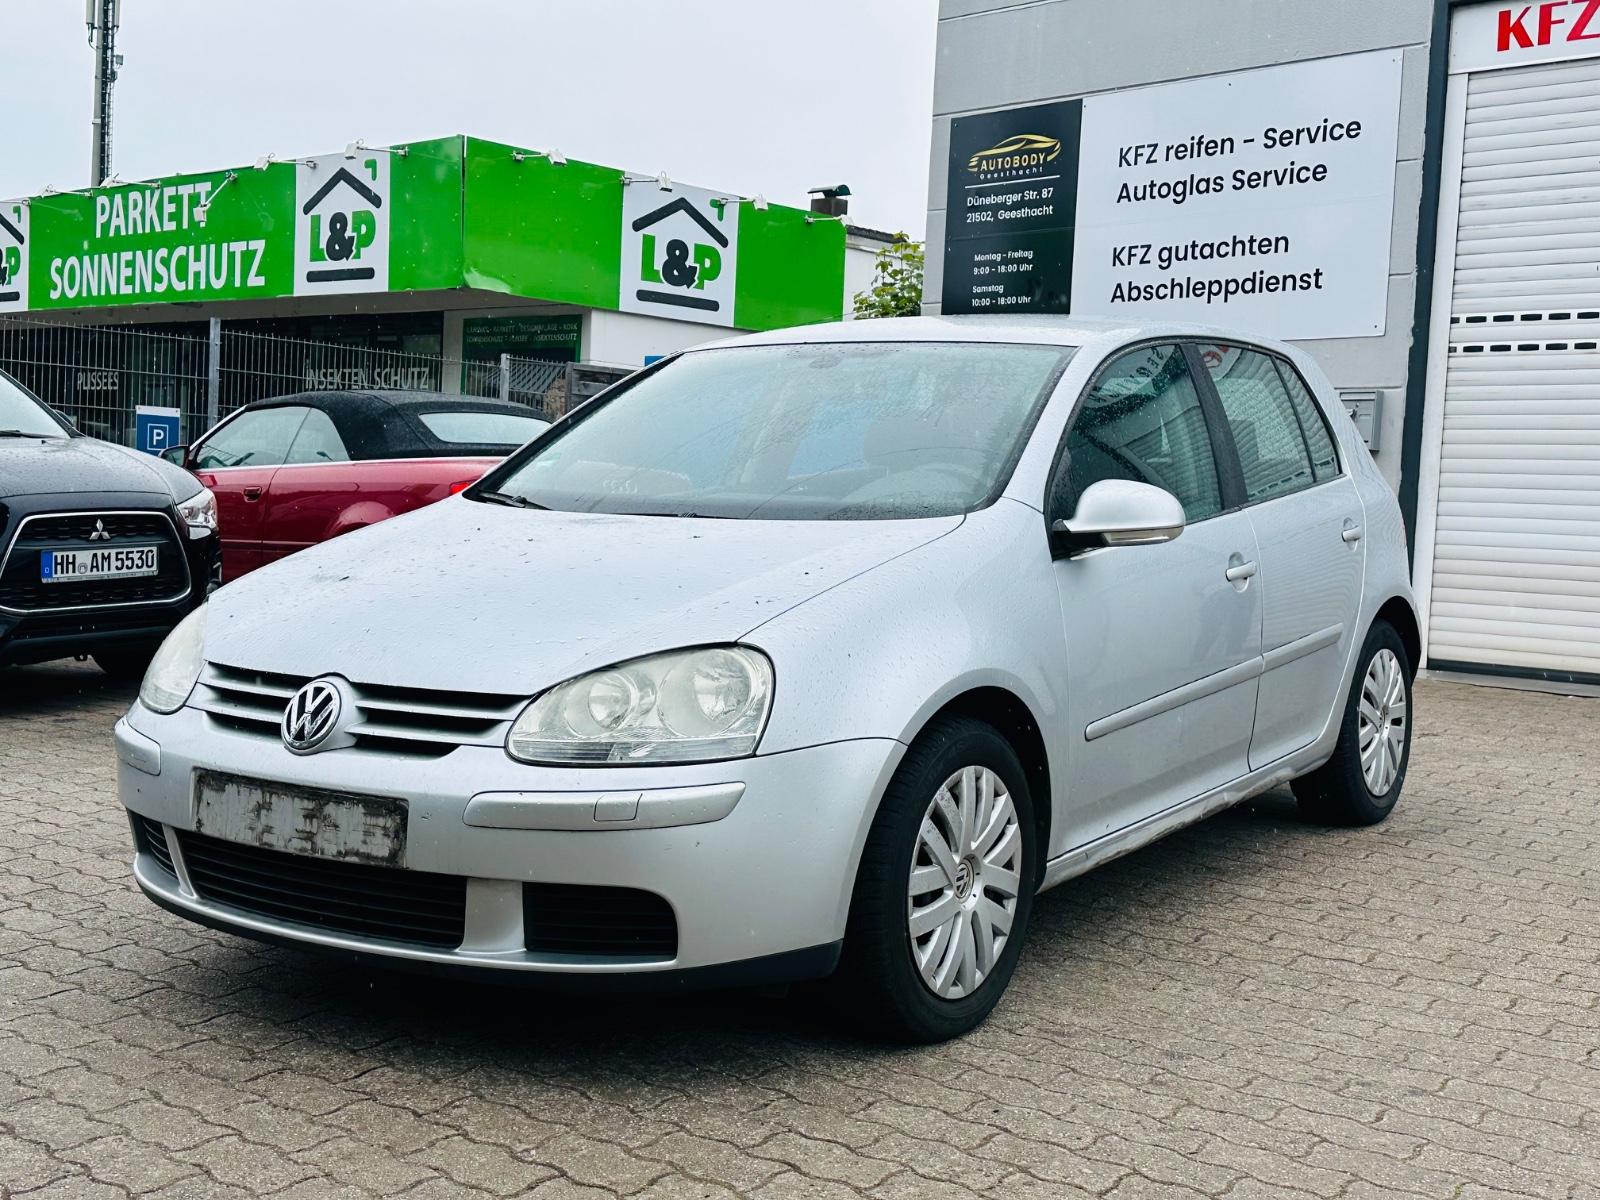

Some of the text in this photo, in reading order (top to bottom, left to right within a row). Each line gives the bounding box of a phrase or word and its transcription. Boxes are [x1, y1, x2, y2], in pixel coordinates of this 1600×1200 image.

[1497, 0, 1600, 52] KFZ
[1118, 142, 1159, 168] KFZ
[1164, 134, 1235, 163] reifen
[1263, 118, 1362, 150] Service
[979, 166, 1043, 180] Geesthacht
[980, 152, 1046, 171] AUTOBODY
[1116, 161, 1328, 205] Autoglas Service
[966, 187, 1054, 207] Düneberger Str. 87
[95, 181, 212, 239] PARKETT
[966, 204, 1054, 223] 21502, Geesthacht
[309, 209, 377, 263] L&P
[640, 232, 722, 291] L&P
[974, 251, 1001, 262] Montag
[1007, 249, 1034, 260] Freitag
[1111, 234, 1290, 271] KFZ gutachten
[49, 239, 266, 300] SONNENSCHUTZ
[973, 266, 990, 275] 9:00
[997, 263, 1017, 273] 18:00
[1019, 263, 1034, 272] Uhr
[972, 284, 1004, 294] Samstag
[1110, 267, 1324, 305] Abschleppdienst
[971, 298, 991, 307] 10:00
[997, 296, 1017, 305] 18:00
[1017, 295, 1032, 304] Uhr
[373, 366, 430, 390] SCHUTZ
[153, 428, 165, 446] P
[53, 549, 155, 575] HH AM 5530
